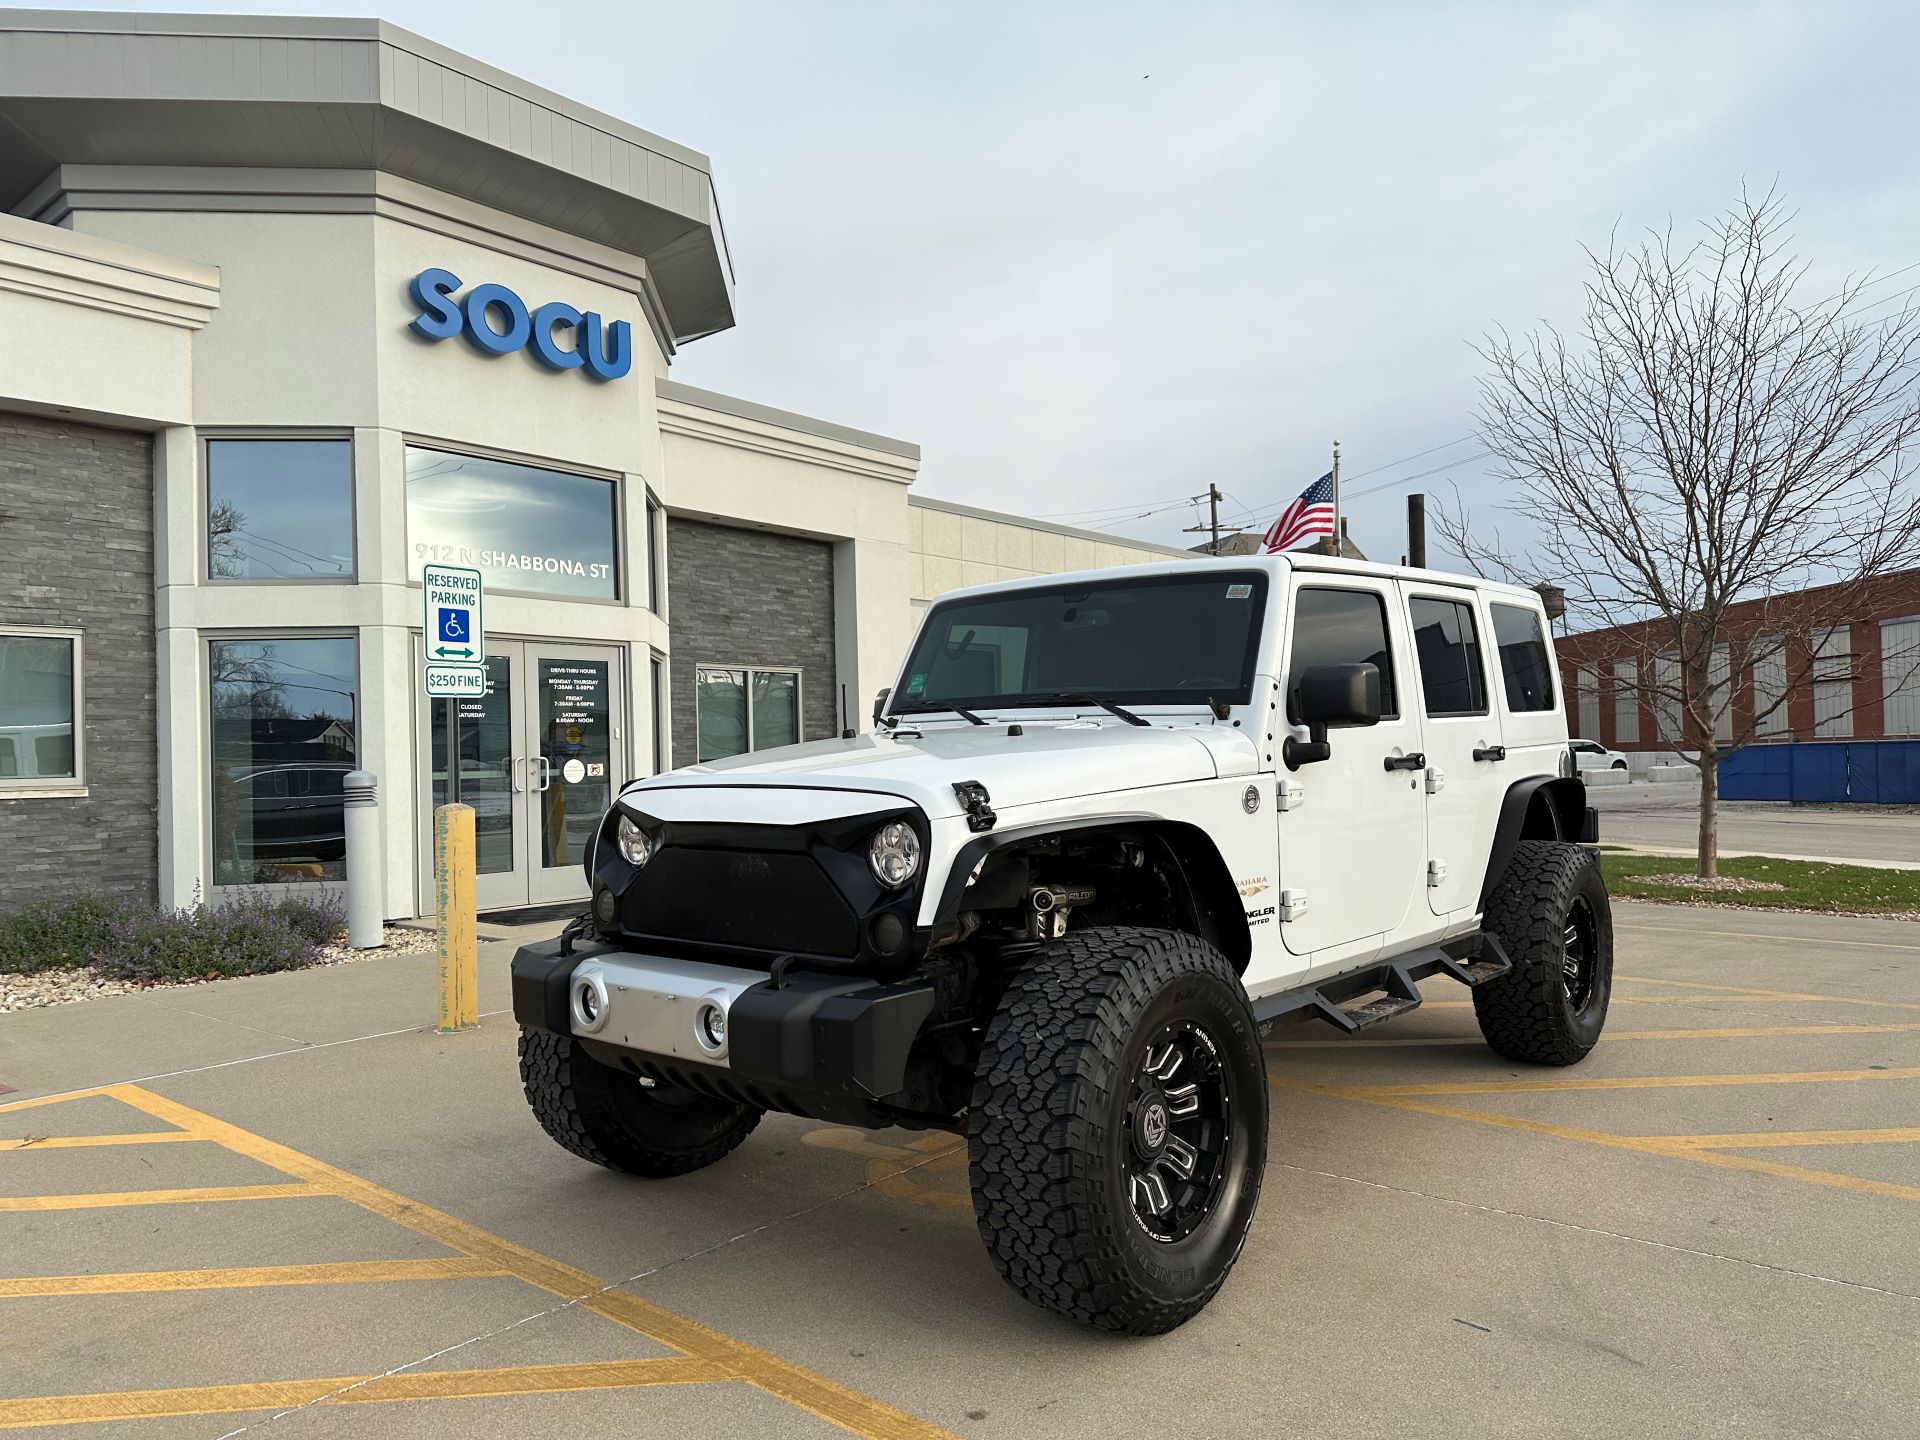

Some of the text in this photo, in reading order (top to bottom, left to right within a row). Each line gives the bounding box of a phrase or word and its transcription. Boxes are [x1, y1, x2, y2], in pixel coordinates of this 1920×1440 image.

[409, 267, 632, 381] SOCU
[415, 542, 609, 579] 912 N SHABBONA ST
[427, 573, 478, 590] RESERVED
[431, 591, 476, 606] PARKING
[429, 673, 456, 687] $250
[457, 675, 481, 687] FINE
[1235, 876, 1268, 887] SAHARA
[1245, 906, 1275, 919] NGLER
[1248, 917, 1270, 926] MITED
